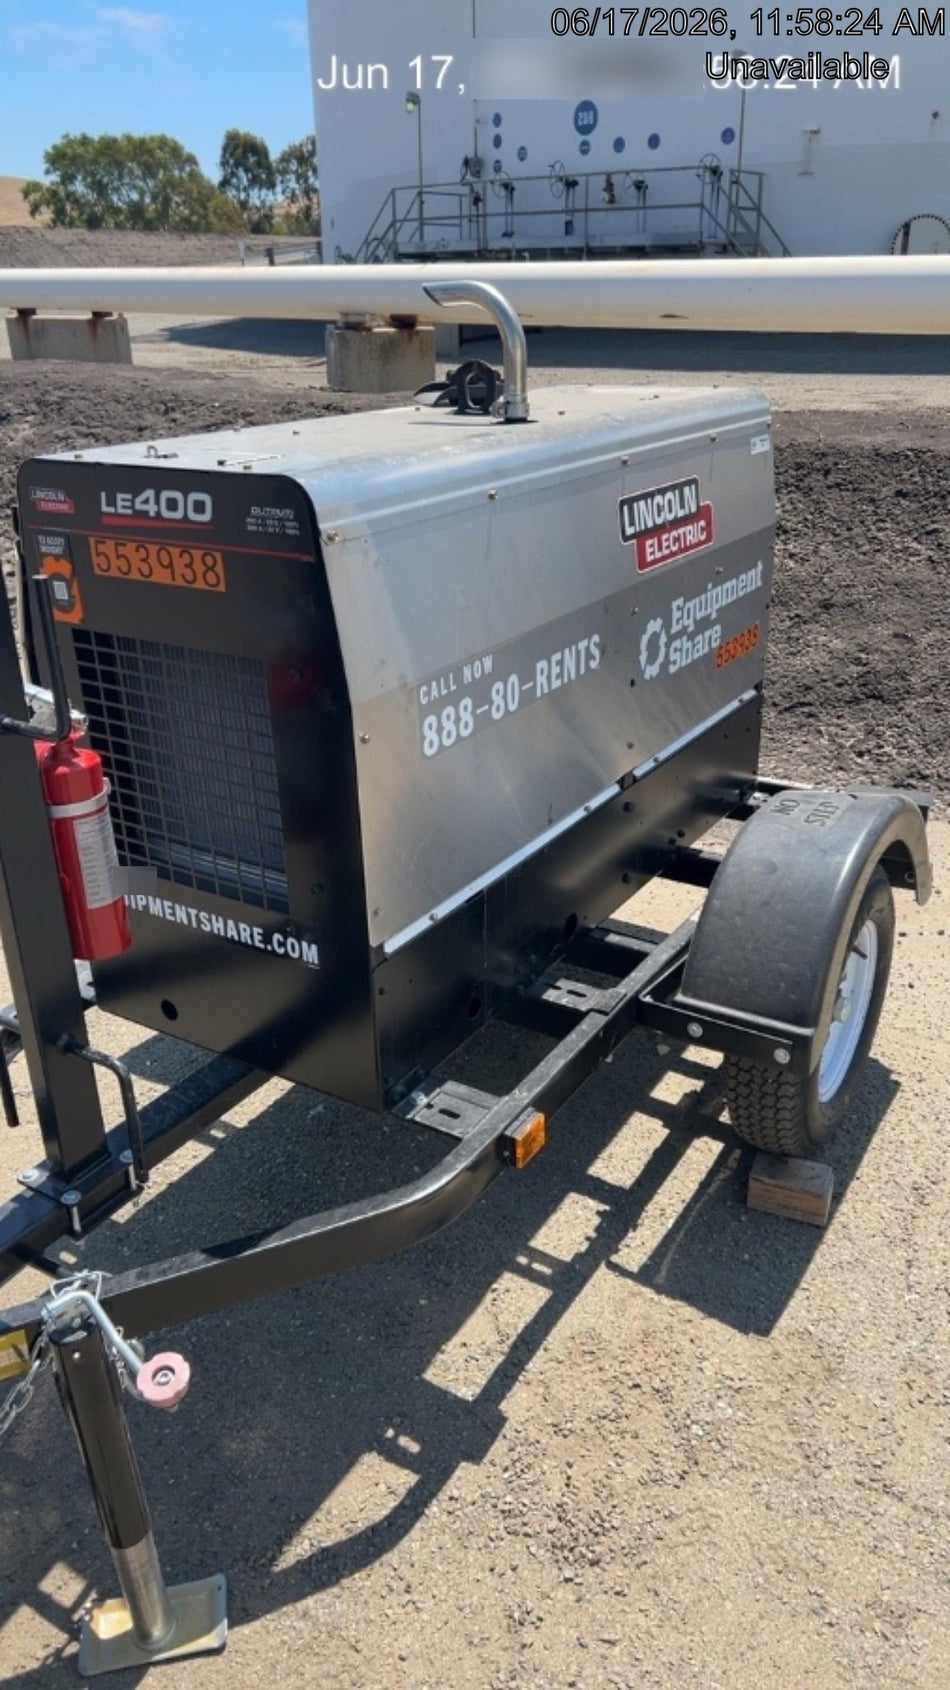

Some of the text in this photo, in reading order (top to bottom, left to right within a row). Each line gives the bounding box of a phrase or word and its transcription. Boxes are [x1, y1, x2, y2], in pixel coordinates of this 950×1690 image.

[100, 488, 213, 523] LE400
[623, 484, 698, 536] LINCOLN
[95, 540, 220, 588] 553938
[645, 520, 707, 562] ELECTRIC
[670, 560, 763, 634] Equipment
[668, 624, 722, 674] Share
[419, 653, 493, 705] CALL NOW
[423, 633, 601, 757] 888-80-RENTS
[124, 894, 319, 965] IPMENTSHARE.COM
